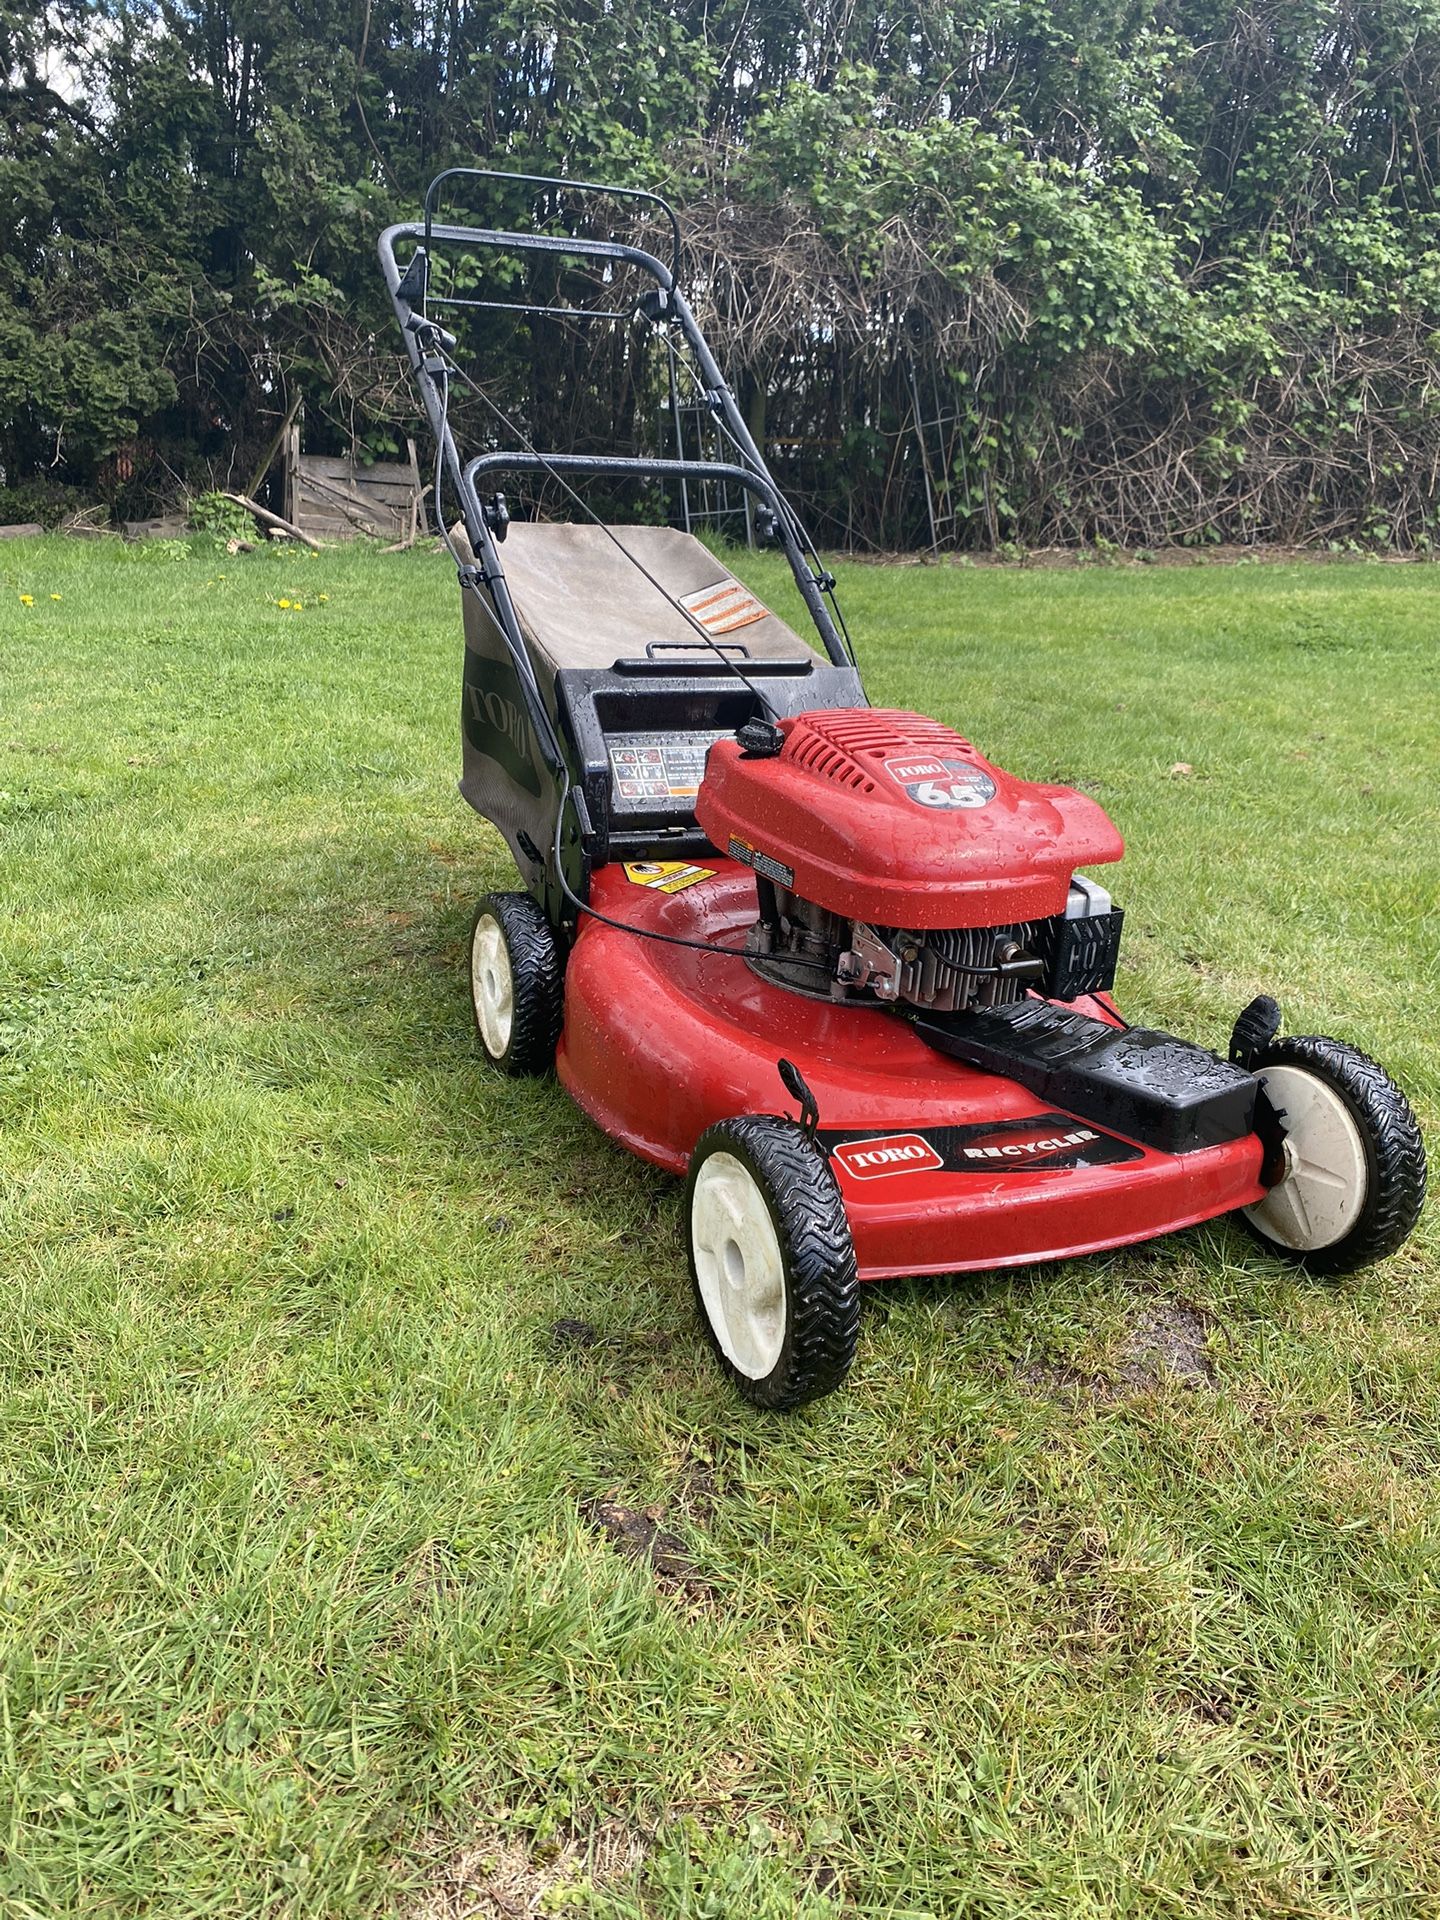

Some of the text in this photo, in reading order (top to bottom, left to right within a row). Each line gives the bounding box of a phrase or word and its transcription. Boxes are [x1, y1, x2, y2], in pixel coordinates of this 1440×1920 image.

[465, 681, 526, 758] TORO
[895, 764, 941, 777] TORO
[1068, 941, 1108, 973] HO
[963, 1130, 1099, 1158] RECYCLER
